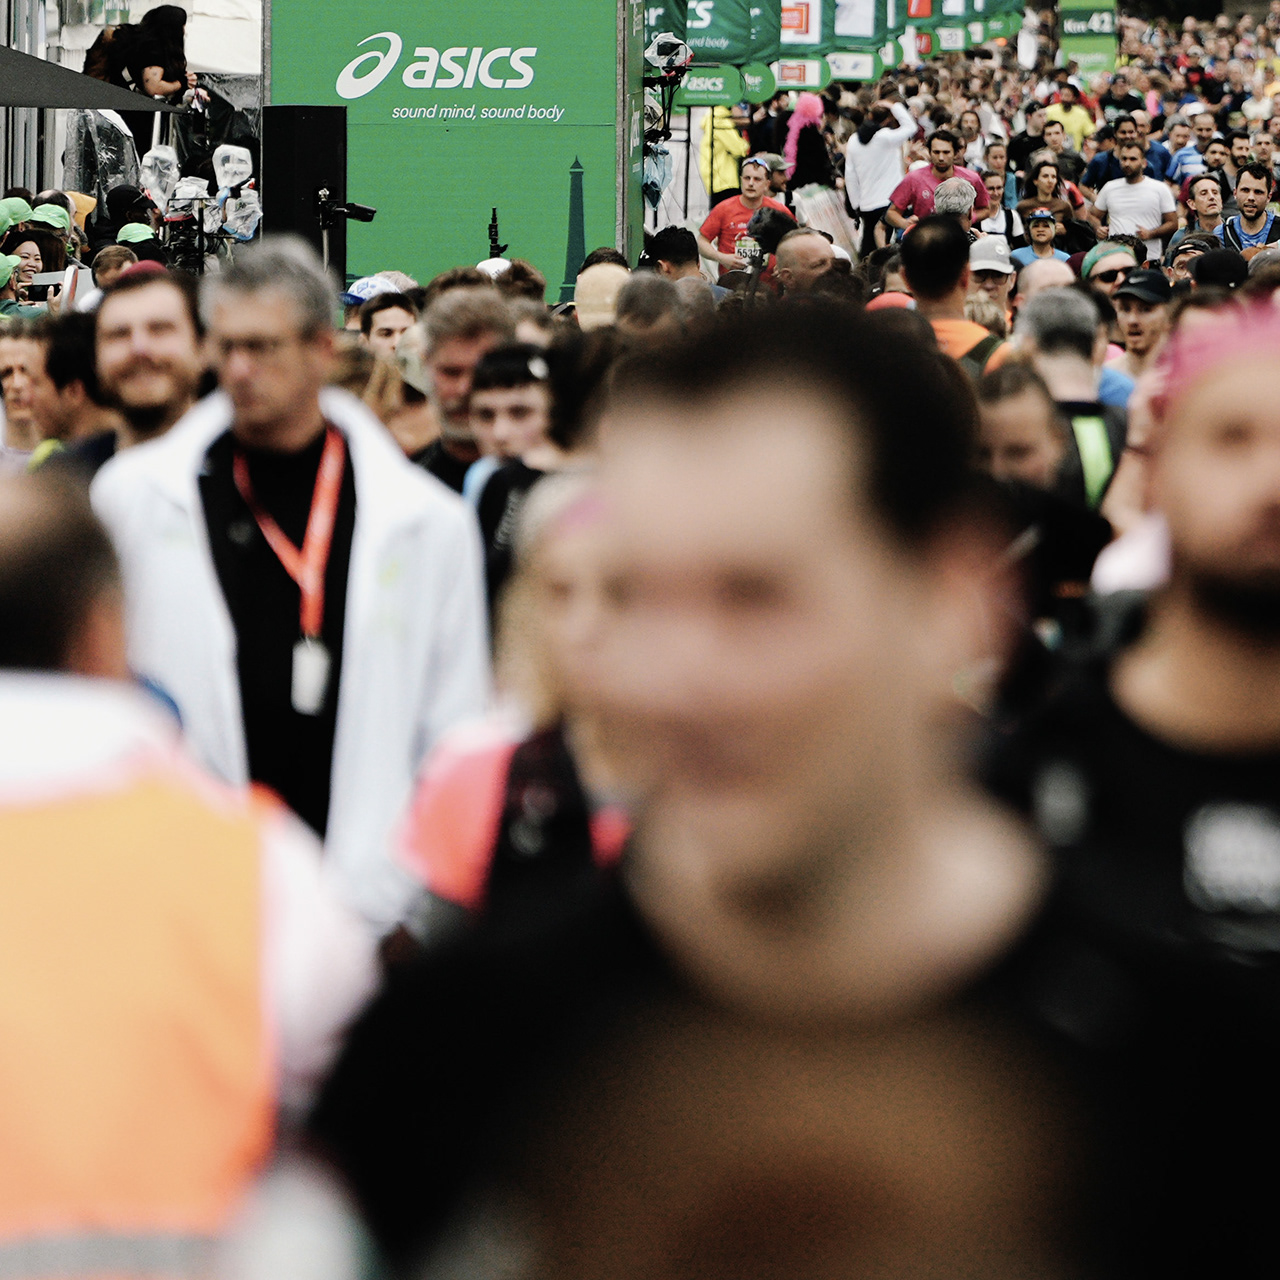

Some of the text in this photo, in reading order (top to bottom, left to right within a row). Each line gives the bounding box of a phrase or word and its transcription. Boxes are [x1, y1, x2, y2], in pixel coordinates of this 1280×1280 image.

[392, 104, 565, 122] sound mind, sound body
